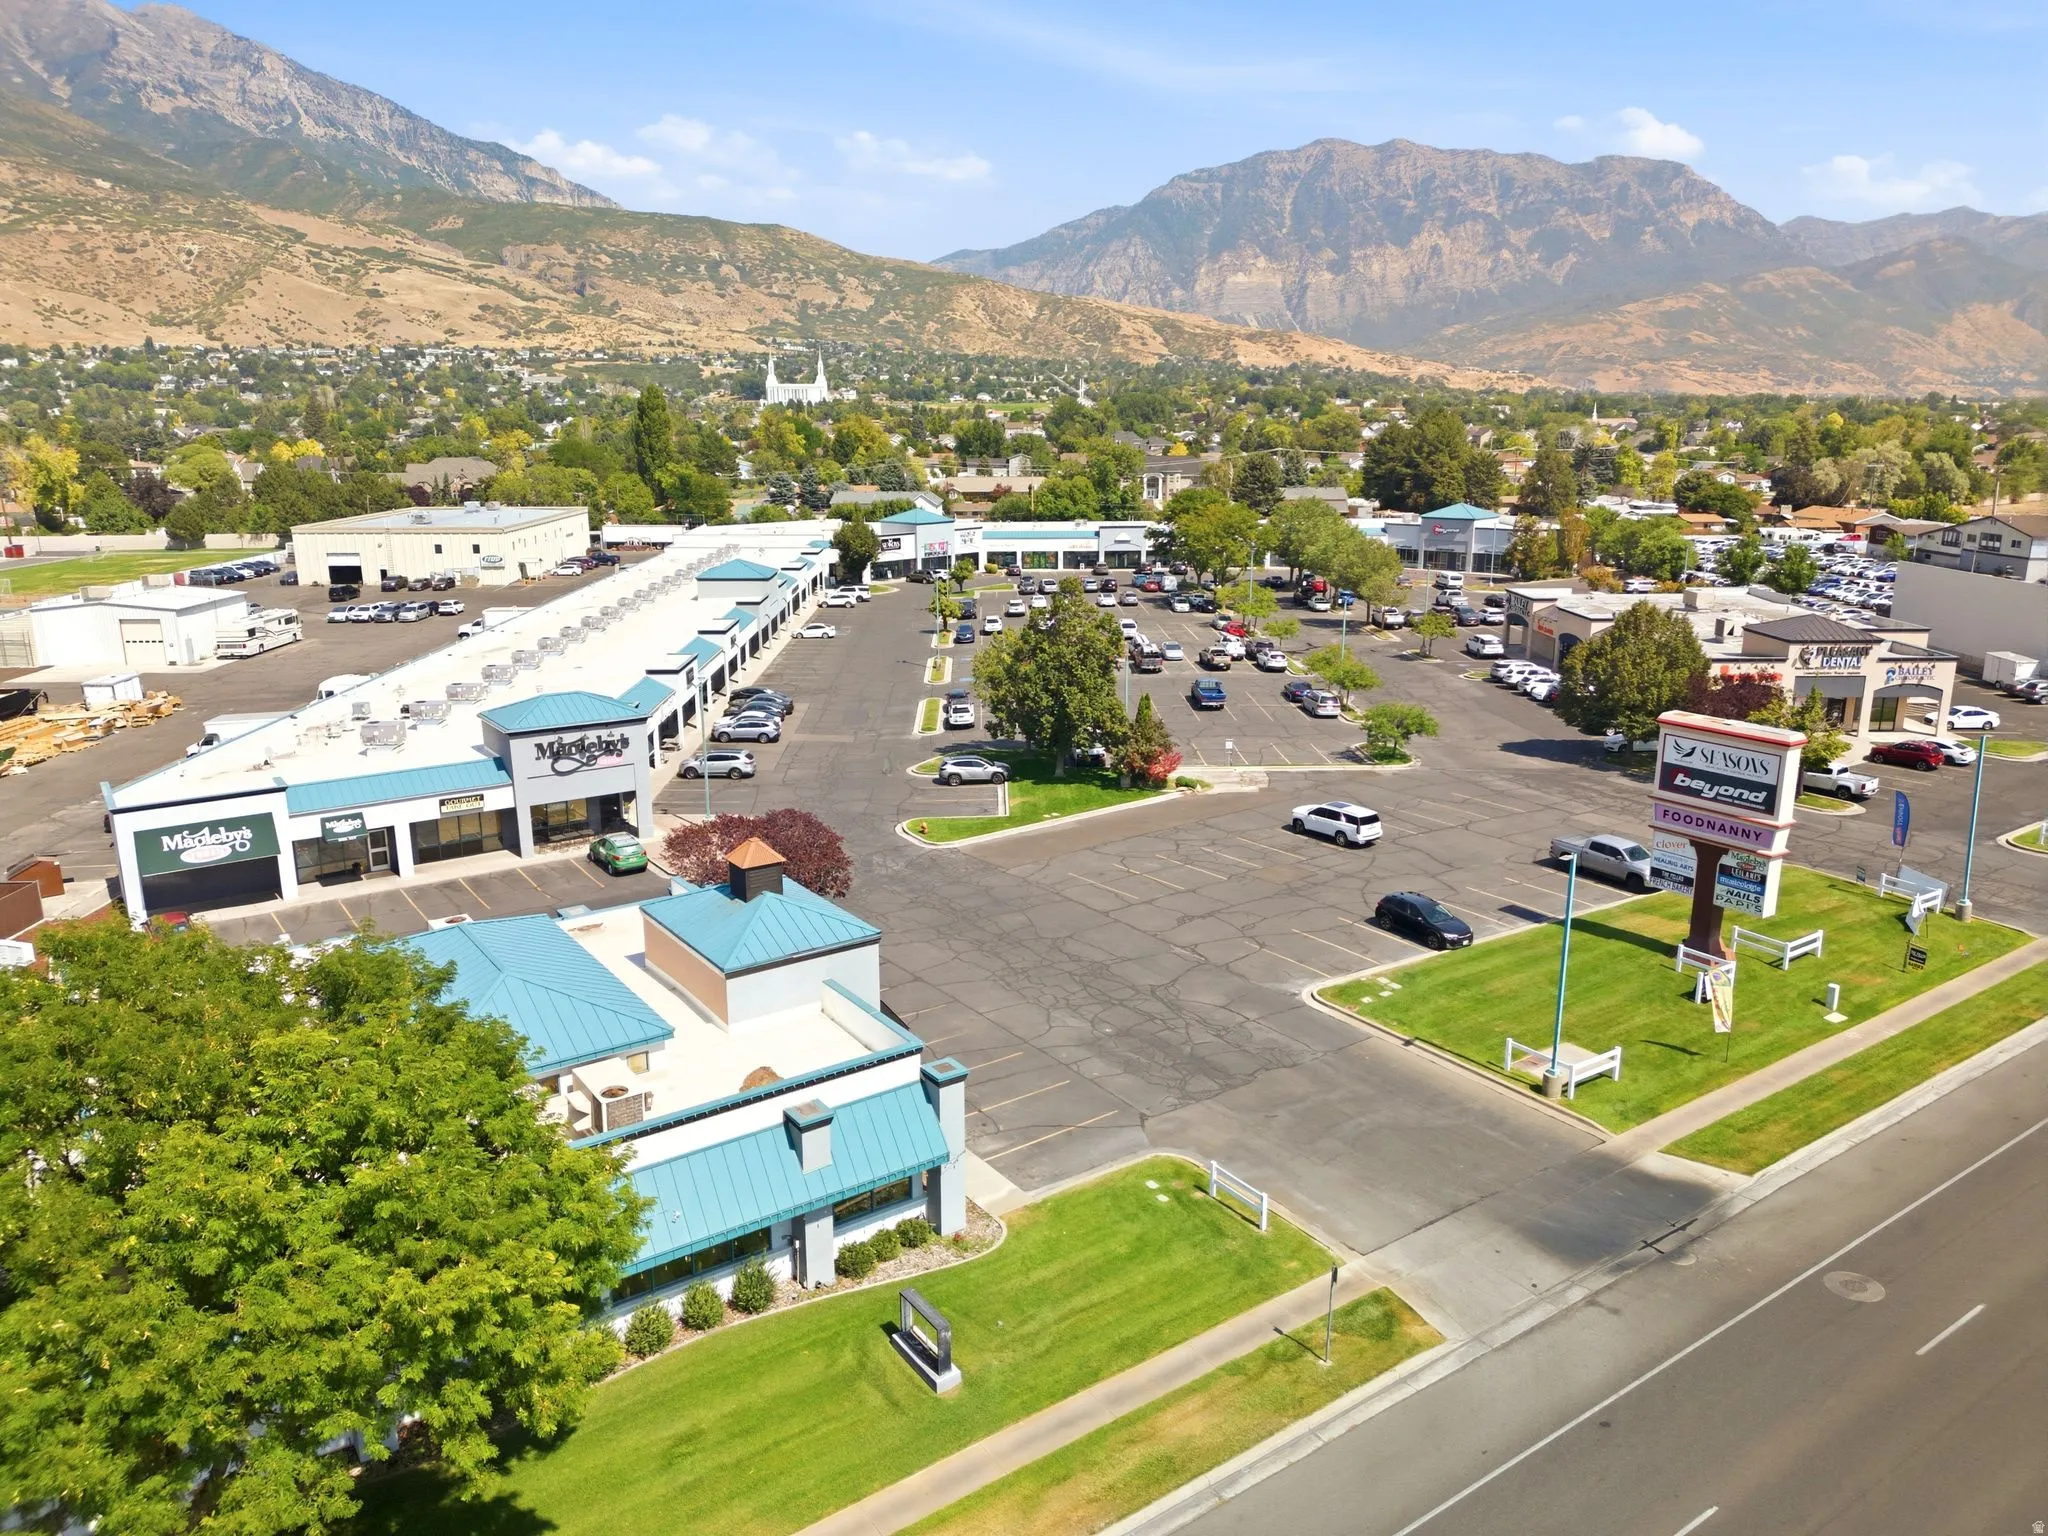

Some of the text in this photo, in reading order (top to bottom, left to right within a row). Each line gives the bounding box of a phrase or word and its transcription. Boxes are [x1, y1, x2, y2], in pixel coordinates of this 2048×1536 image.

[1816, 646, 1873, 657] PLEASANT
[1898, 666, 1934, 676] BAILEY
[1700, 747, 1770, 775] SEASONS
[1673, 773, 1767, 803] beyond
[1663, 809, 1762, 841] FOODNANNY
[160, 826, 253, 852] Magleby's
[1656, 840, 1687, 849] clover
[1726, 889, 1761, 904] NAILS
